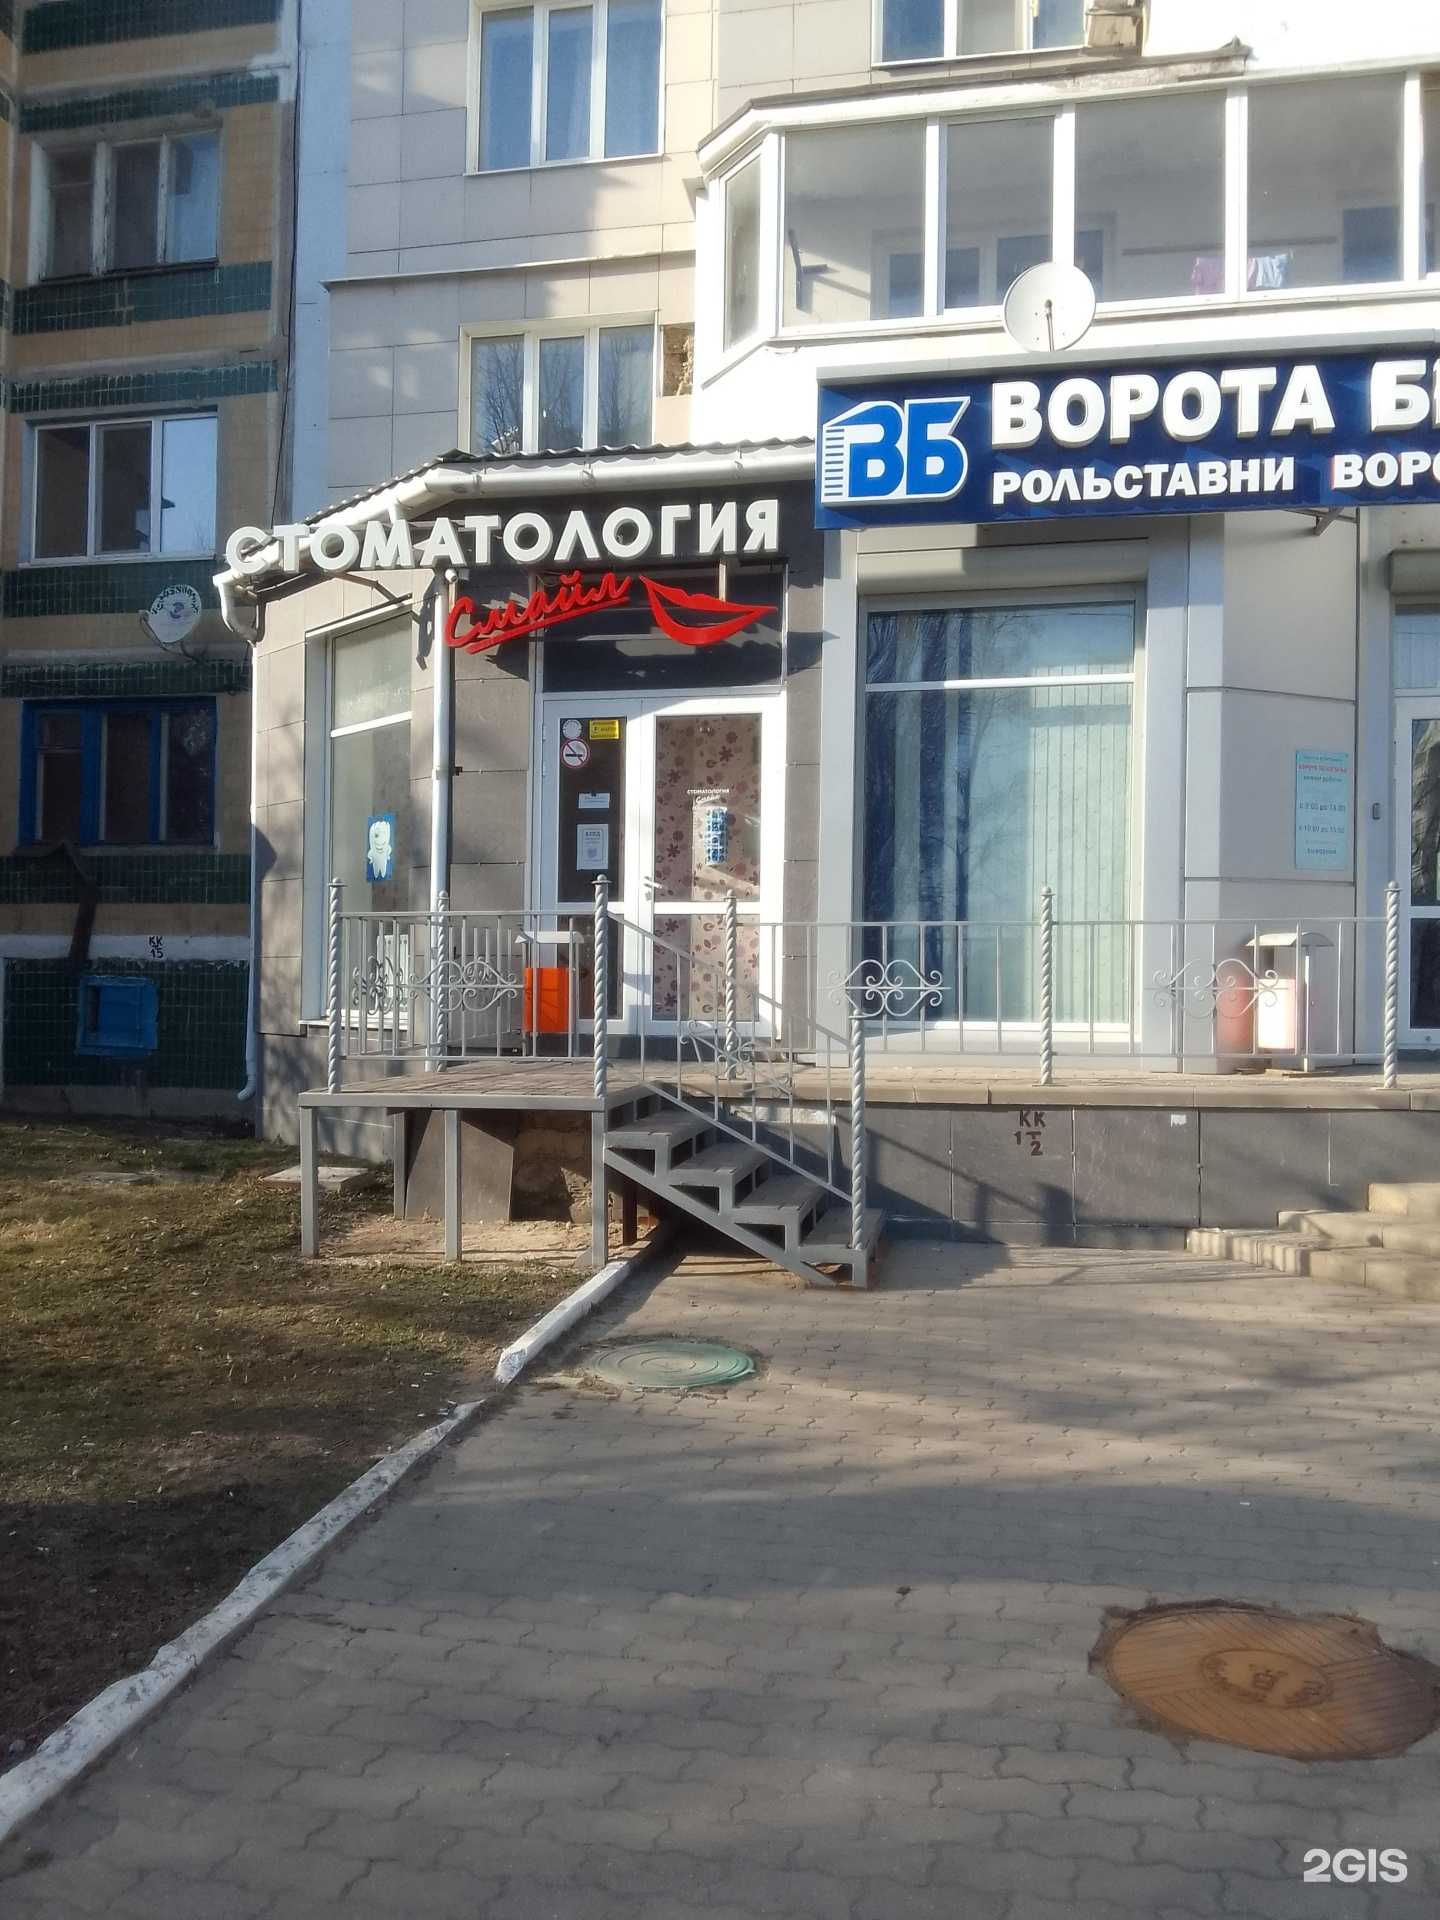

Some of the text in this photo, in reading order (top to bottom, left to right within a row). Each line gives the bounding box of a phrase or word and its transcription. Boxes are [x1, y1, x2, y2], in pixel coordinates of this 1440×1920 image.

[992, 363, 1336, 449] ВОРОТА
[992, 456, 1296, 505] РОЛЬСТАВНИ
[225, 498, 779, 575] СТОМАТОЛОГИЯ
[444, 570, 633, 652] Смайл
